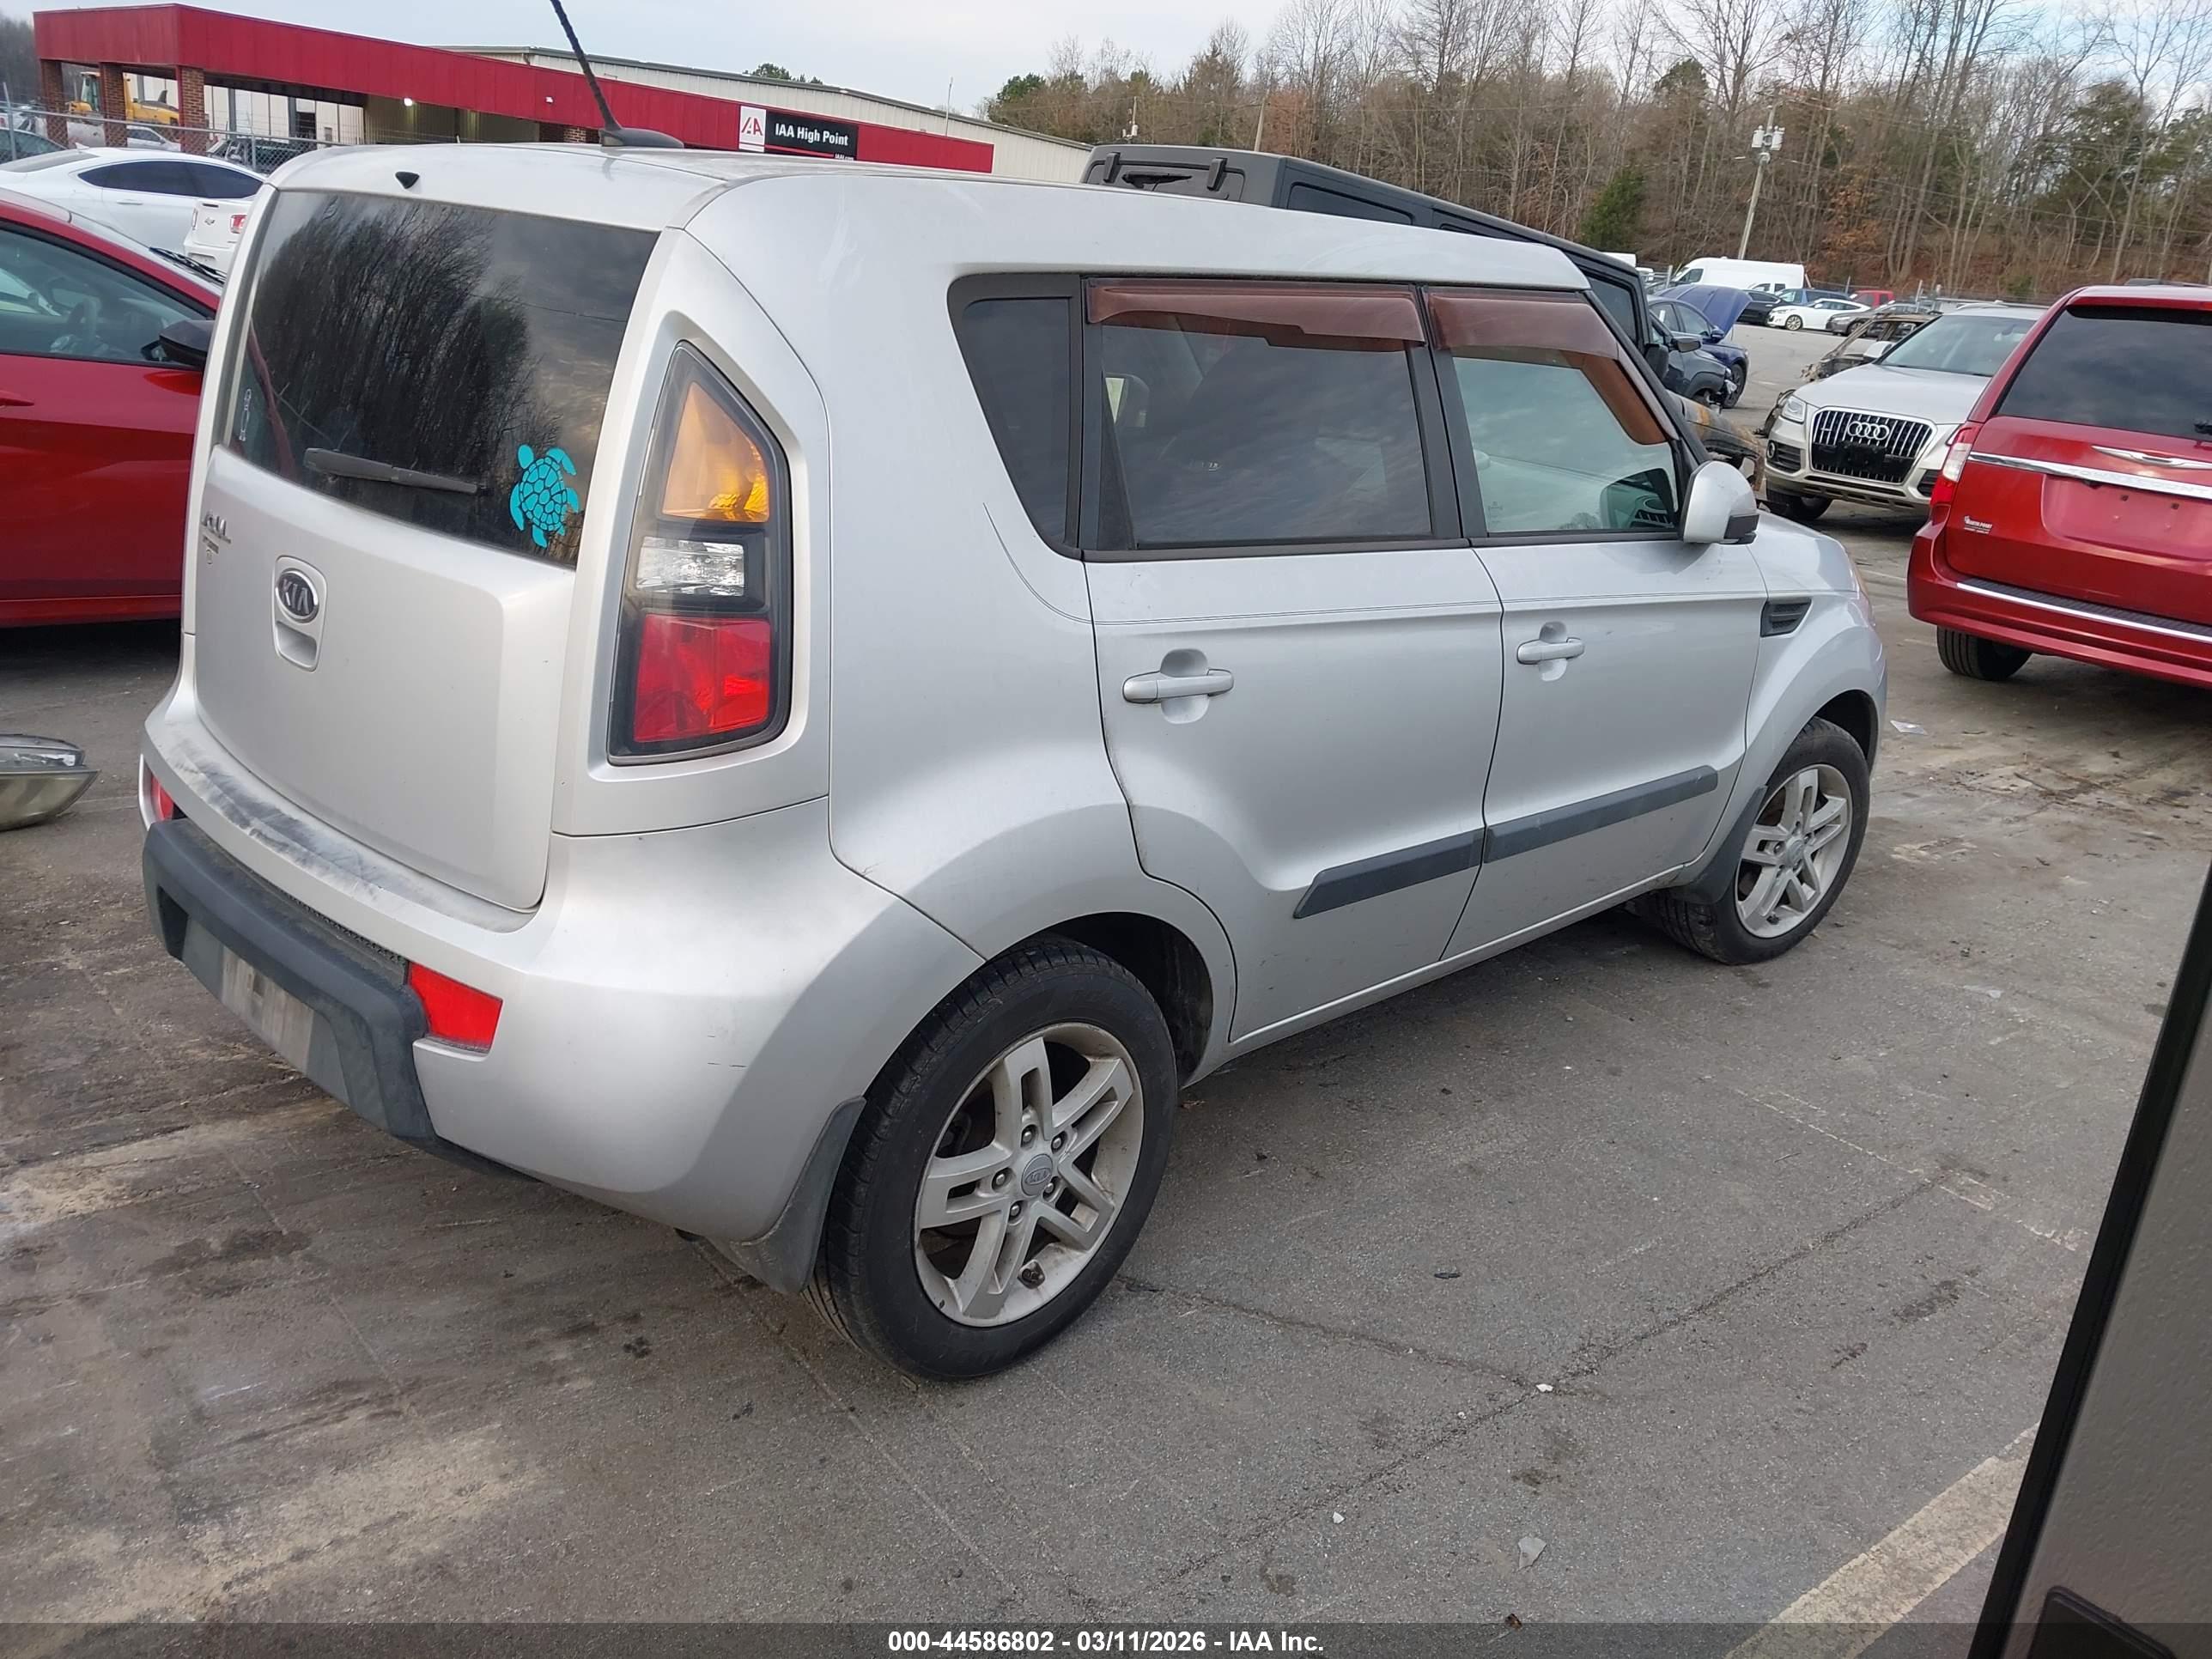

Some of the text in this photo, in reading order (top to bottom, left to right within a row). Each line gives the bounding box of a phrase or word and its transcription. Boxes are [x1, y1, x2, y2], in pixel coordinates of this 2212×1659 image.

[775, 123, 849, 146] IAA High Point
[282, 578, 310, 615] KIA
